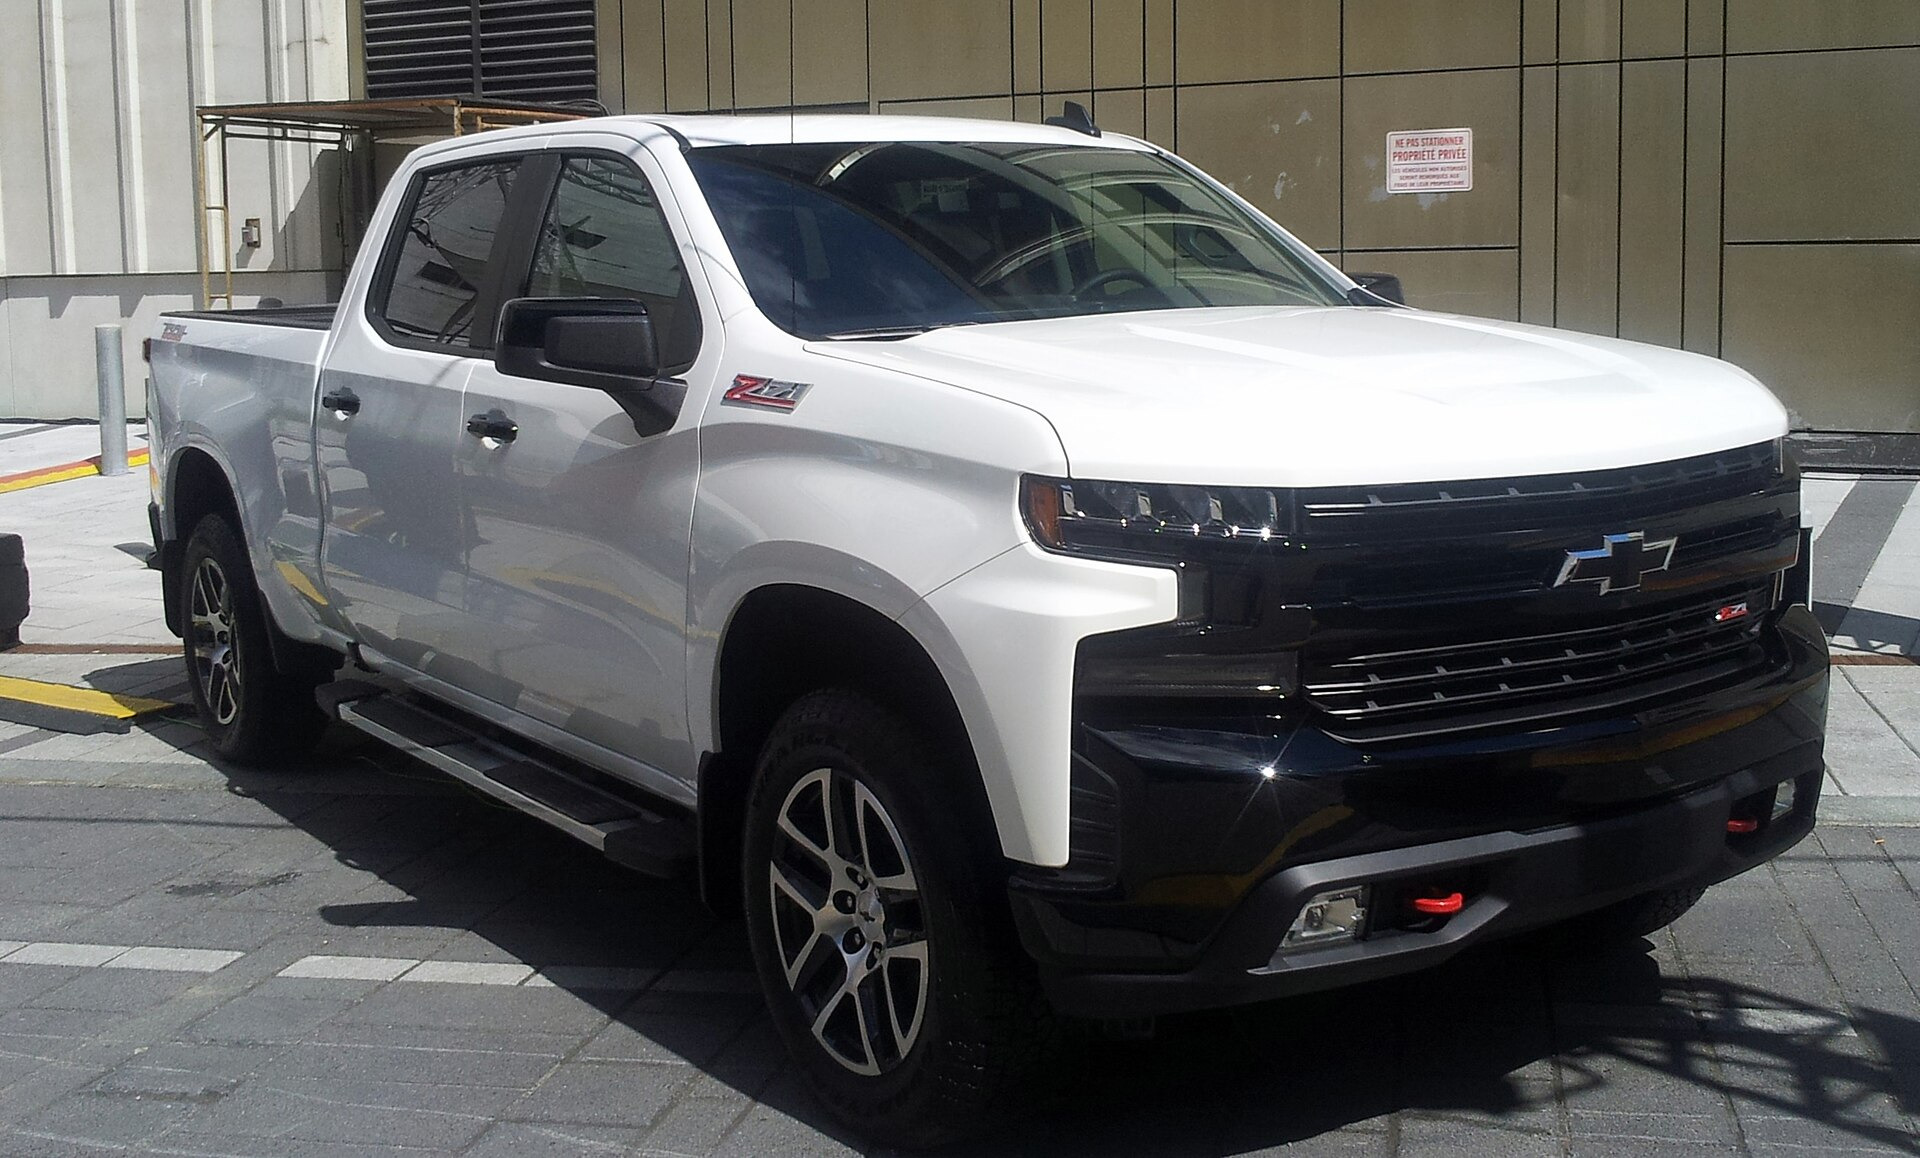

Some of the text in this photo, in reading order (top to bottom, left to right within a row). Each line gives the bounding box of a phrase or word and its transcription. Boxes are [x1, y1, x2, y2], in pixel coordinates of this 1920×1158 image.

[1395, 136, 1464, 148] NE PAS STATIONNER
[1439, 147, 1467, 160] PRIVÉE
[721, 373, 814, 414] Z71
